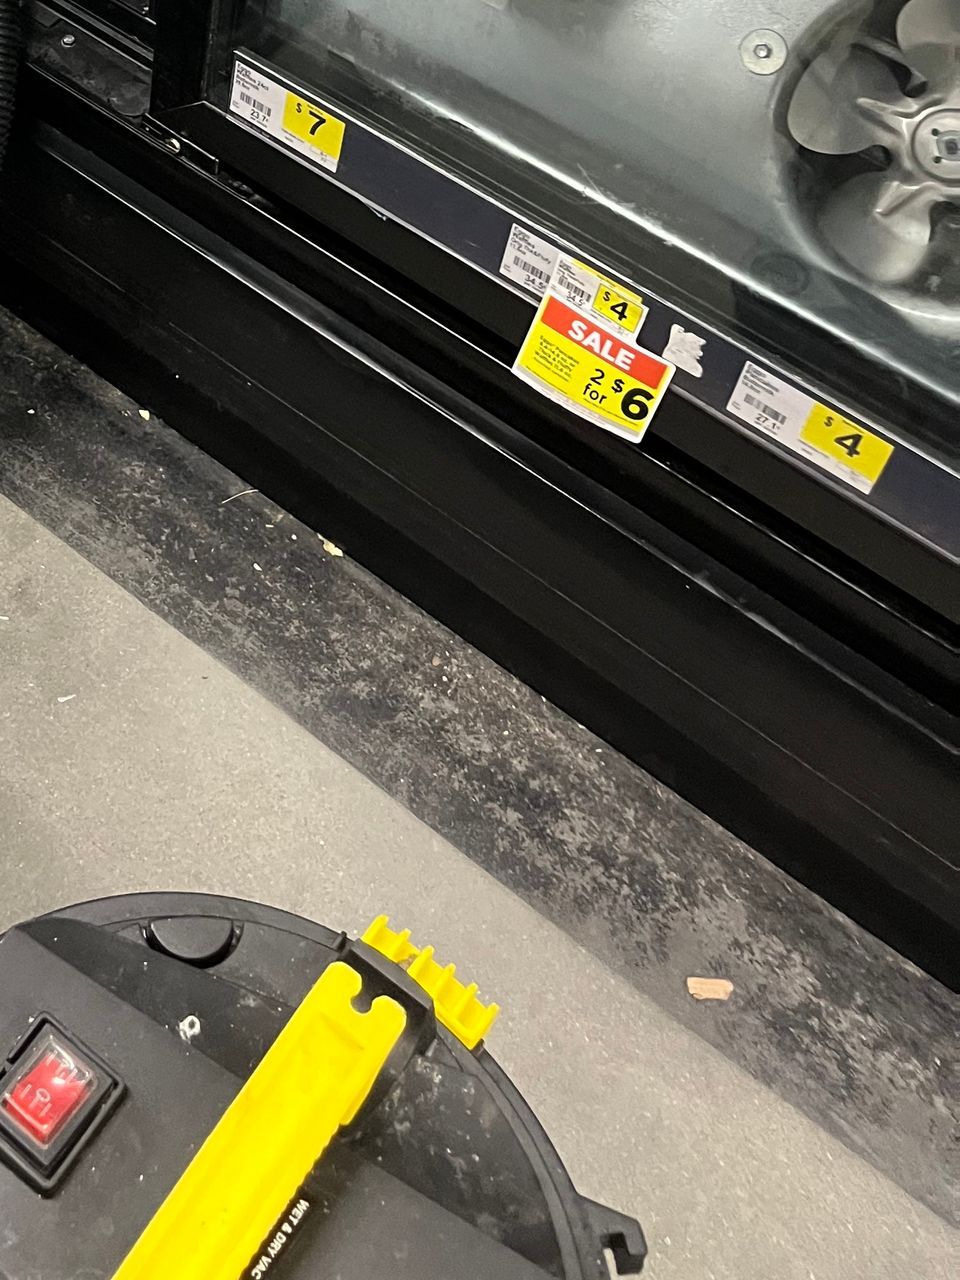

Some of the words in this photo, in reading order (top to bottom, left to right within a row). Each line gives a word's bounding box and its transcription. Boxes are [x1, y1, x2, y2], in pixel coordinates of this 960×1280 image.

[567, 320, 636, 371] SALE
[590, 368, 606, 386] 2
[582, 383, 607, 404] for
[288, 1199, 310, 1226] WET
[267, 1231, 287, 1258] DRY
[251, 1255, 272, 1280] VAC
